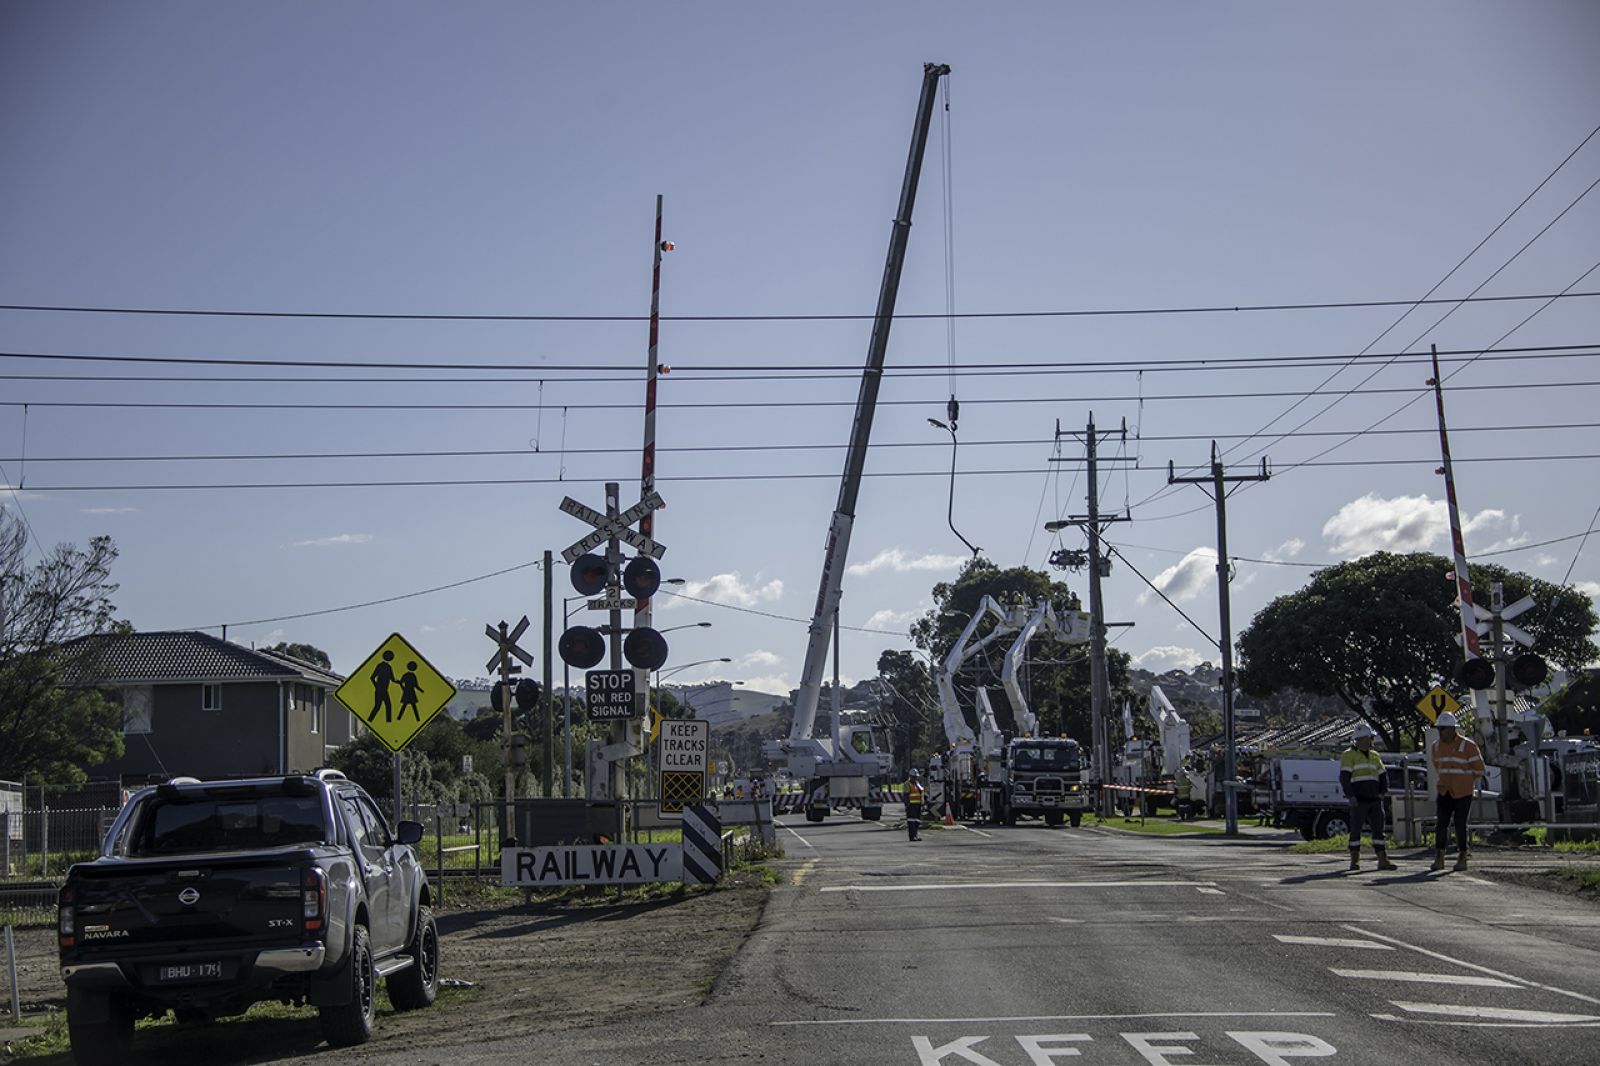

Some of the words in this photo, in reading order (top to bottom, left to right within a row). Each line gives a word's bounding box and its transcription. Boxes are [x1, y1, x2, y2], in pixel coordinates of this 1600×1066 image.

[571, 499, 655, 557] CROSSING
[608, 588, 616, 598] 2
[592, 600, 634, 609] TRACKS
[590, 674, 631, 690] STOP
[590, 693, 605, 704] ON
[610, 692, 631, 702] RED
[592, 705, 631, 716] SIGNAL
[670, 724, 698, 737] KEEP
[663, 739, 705, 752] TRACKS
[665, 753, 702, 766] CLEAR
[516, 848, 668, 882] RAILWAY
[84, 929, 130, 940] NAVARA
